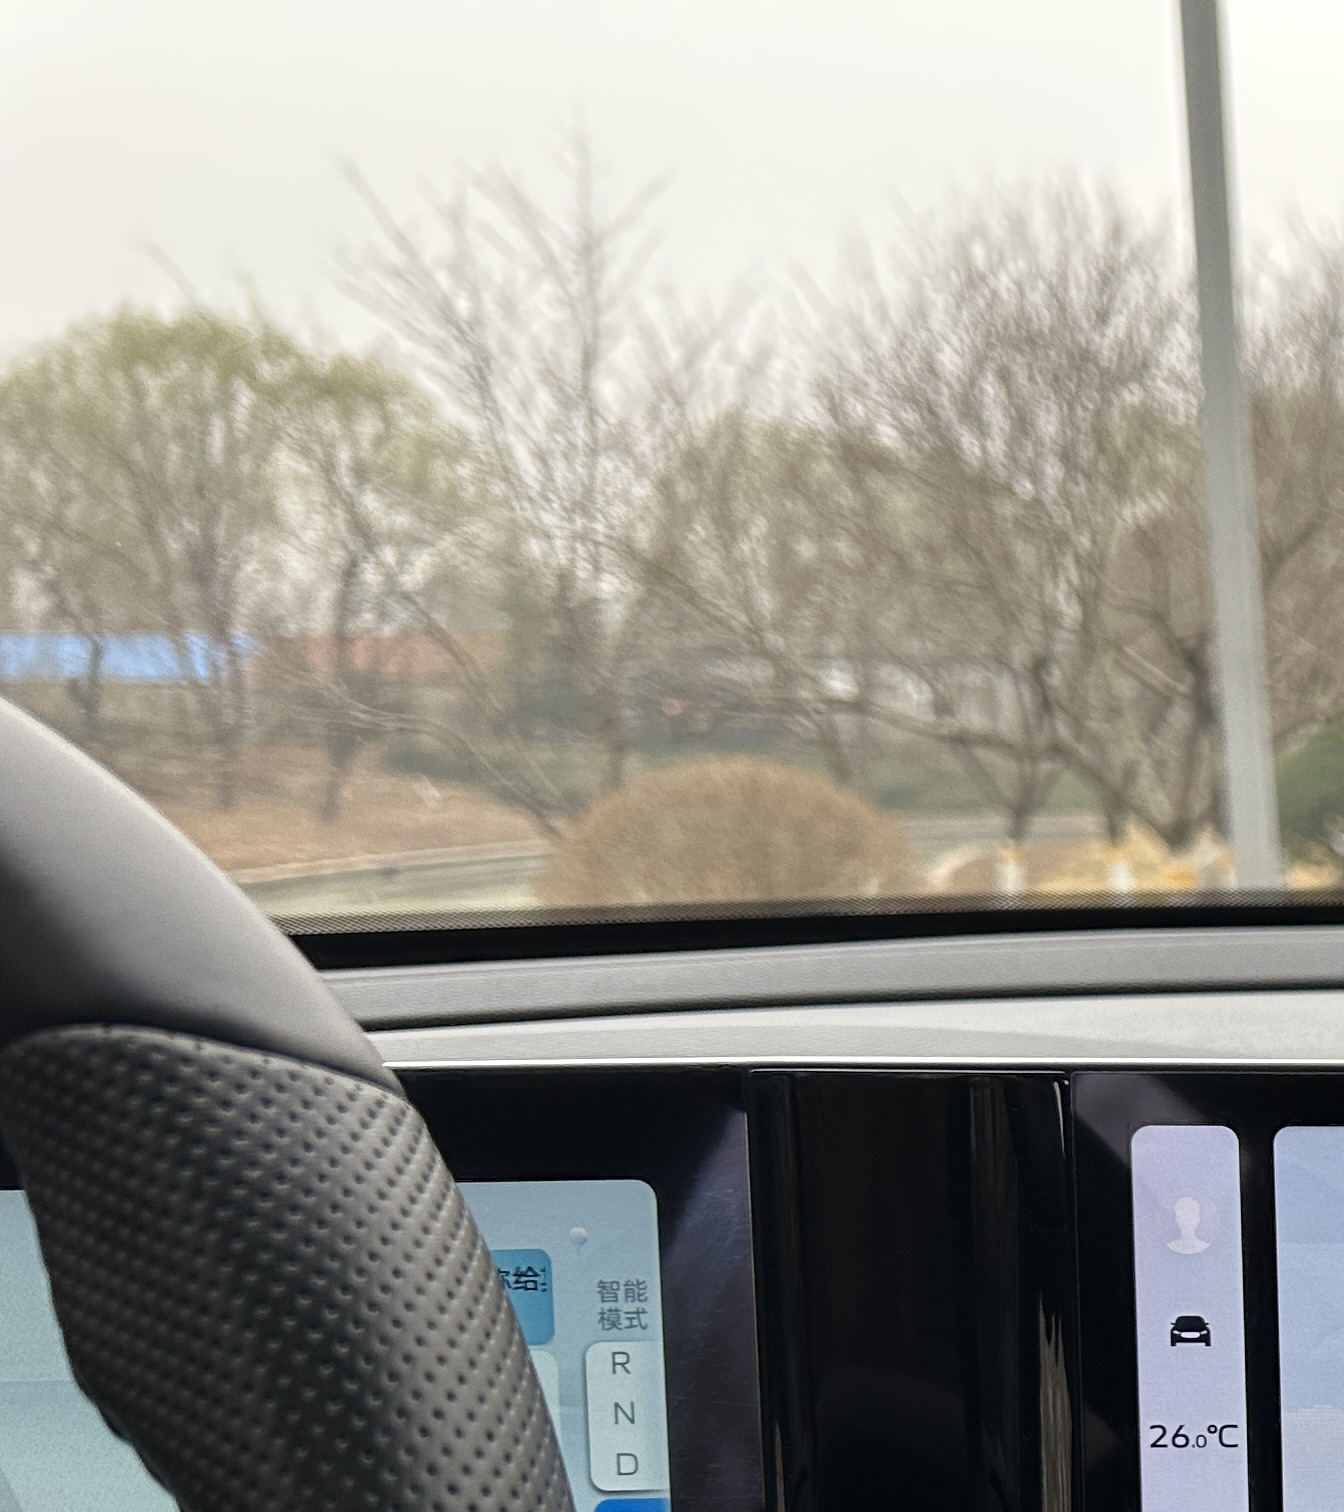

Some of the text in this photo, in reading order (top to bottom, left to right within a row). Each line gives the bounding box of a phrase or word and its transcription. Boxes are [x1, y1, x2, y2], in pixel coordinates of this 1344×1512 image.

[597, 1278, 649, 1303] 智能
[597, 1307, 649, 1331] 模式
[611, 1351, 632, 1374] R
[614, 1402, 636, 1425] N
[616, 1452, 639, 1475] D
